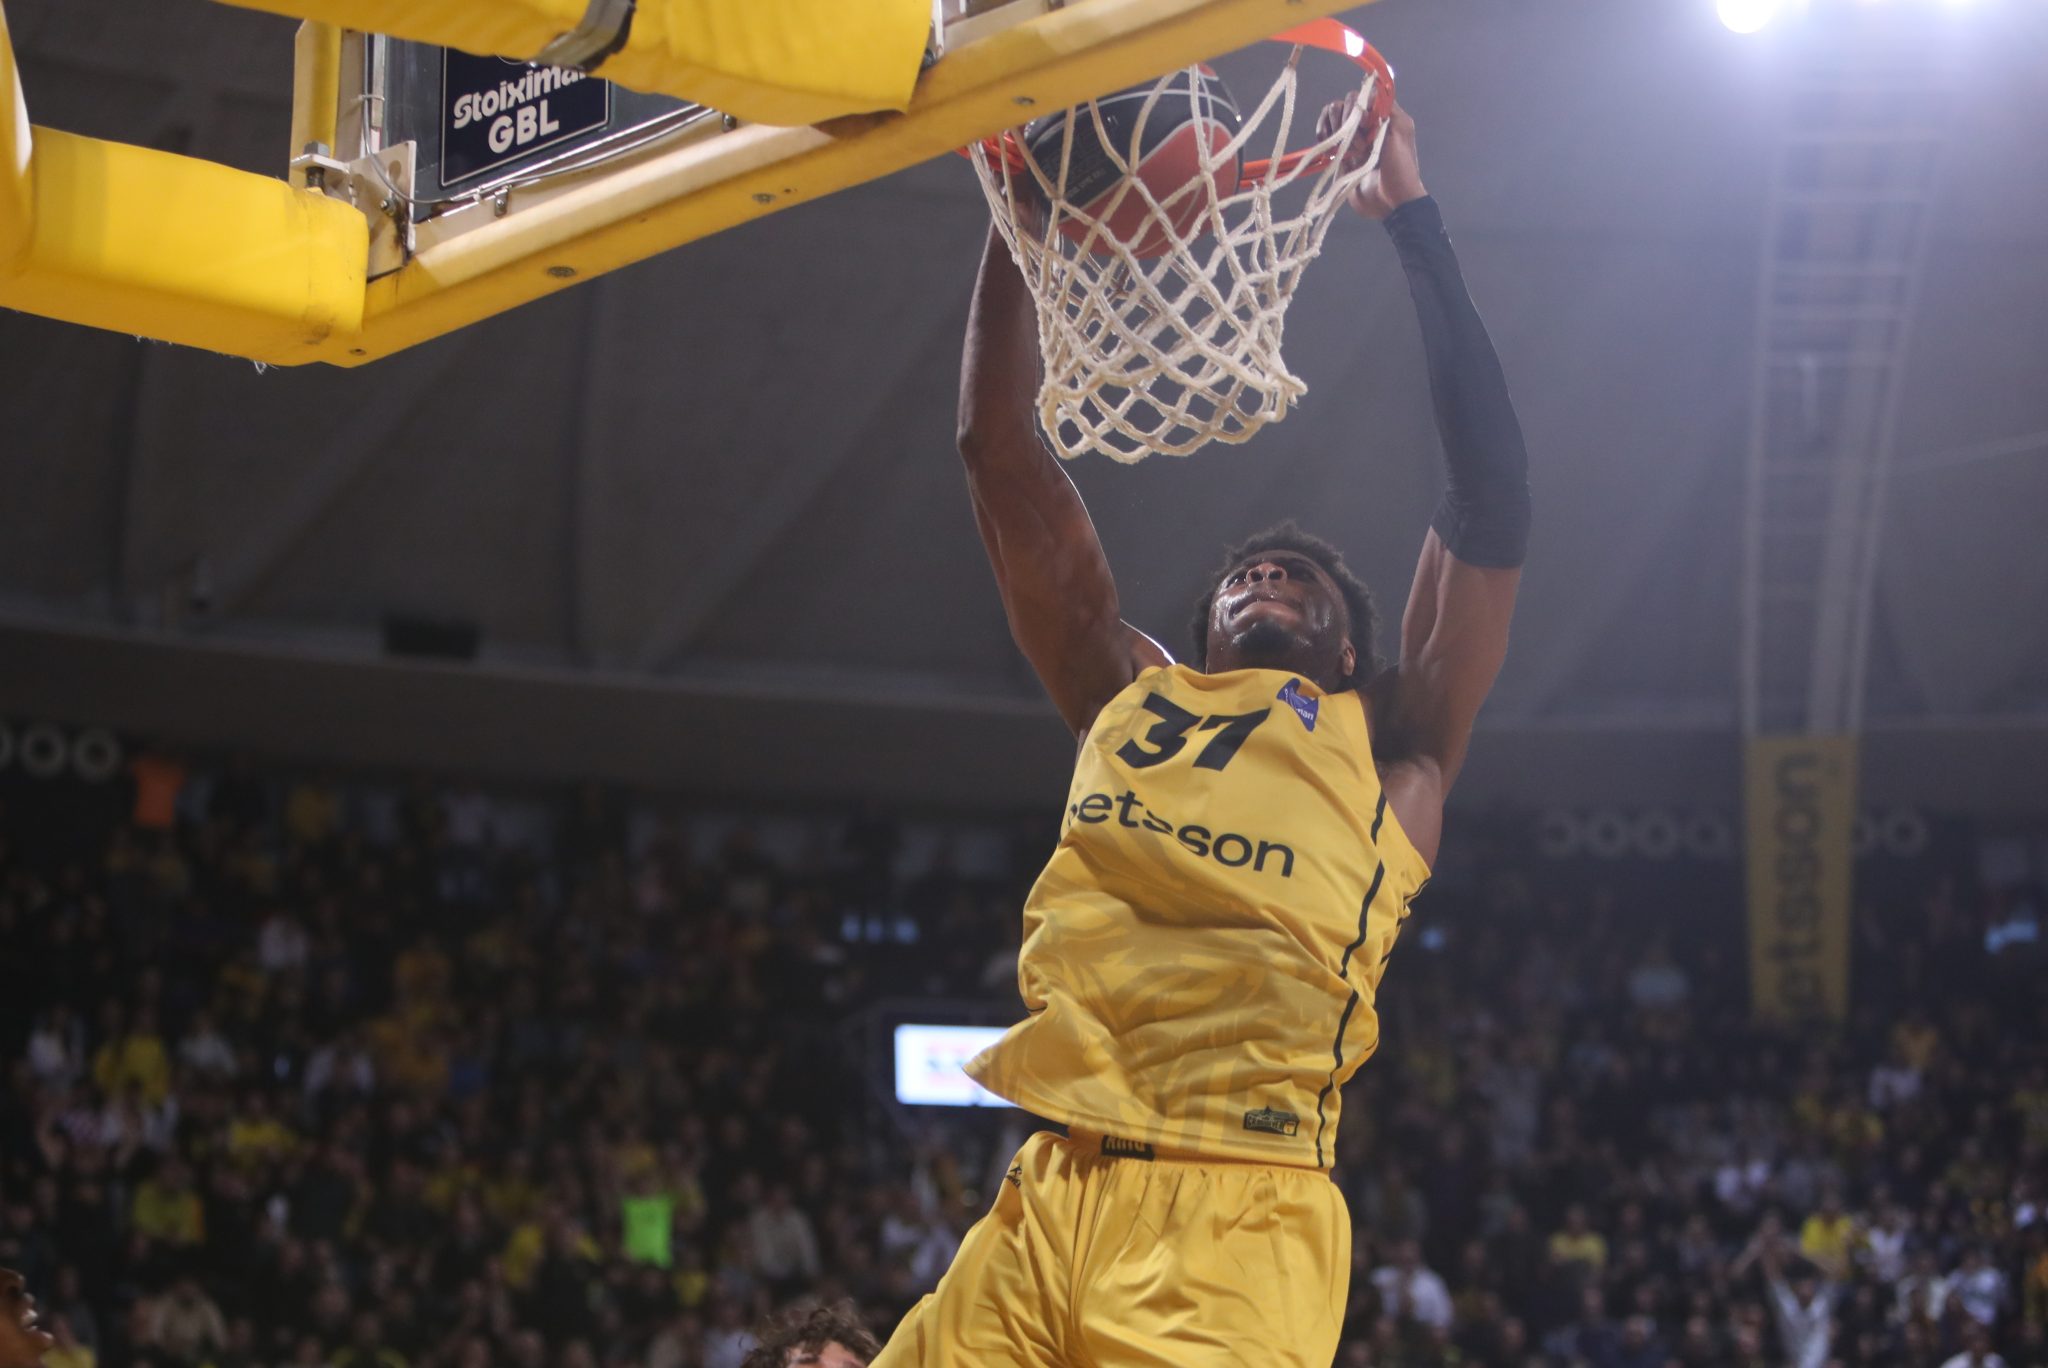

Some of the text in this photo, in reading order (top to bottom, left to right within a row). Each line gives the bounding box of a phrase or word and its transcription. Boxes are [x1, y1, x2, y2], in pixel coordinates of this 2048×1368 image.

[488, 99, 560, 154] GBL
[1116, 691, 1272, 772] 37
[1067, 790, 1295, 878] etsson
